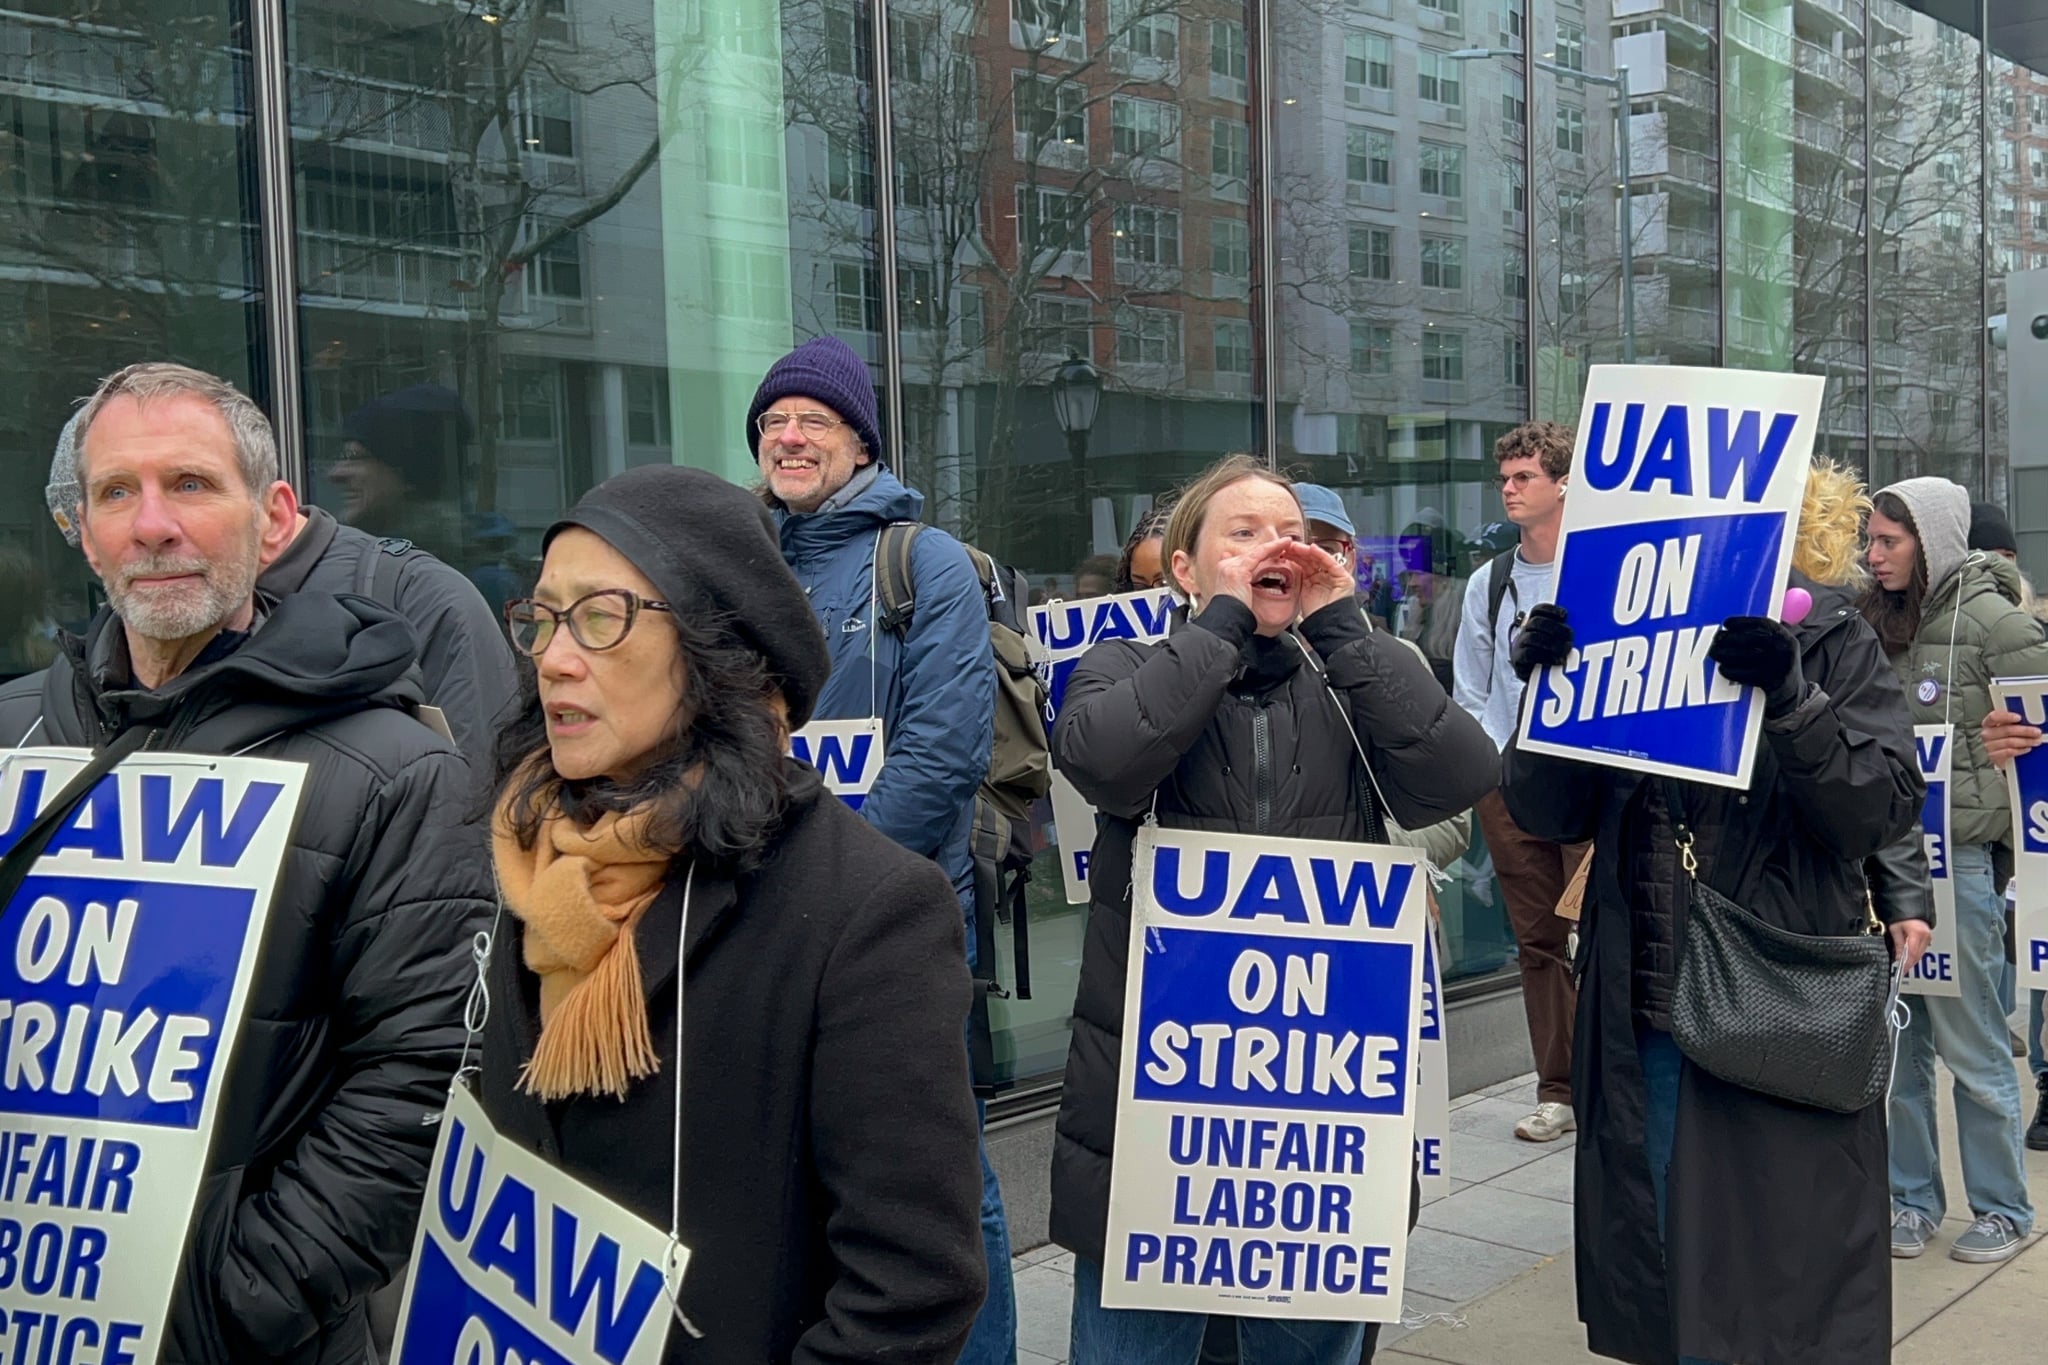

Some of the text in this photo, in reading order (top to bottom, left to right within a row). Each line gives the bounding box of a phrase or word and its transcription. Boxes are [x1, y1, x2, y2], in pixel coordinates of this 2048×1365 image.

[1584, 402, 1799, 503] UAW
[1613, 534, 1701, 626] ON
[1152, 846, 1415, 929] UAW
[16, 896, 139, 987] ON
[1229, 949, 1329, 1017] ON
[1145, 1021, 1401, 1099] STRIKE
[1169, 1115, 1367, 1175] UNFAIR
[438, 1116, 665, 1365] UAW
[1173, 1176, 1352, 1234] LABOR
[1125, 1233, 1392, 1296] PRACTICE
